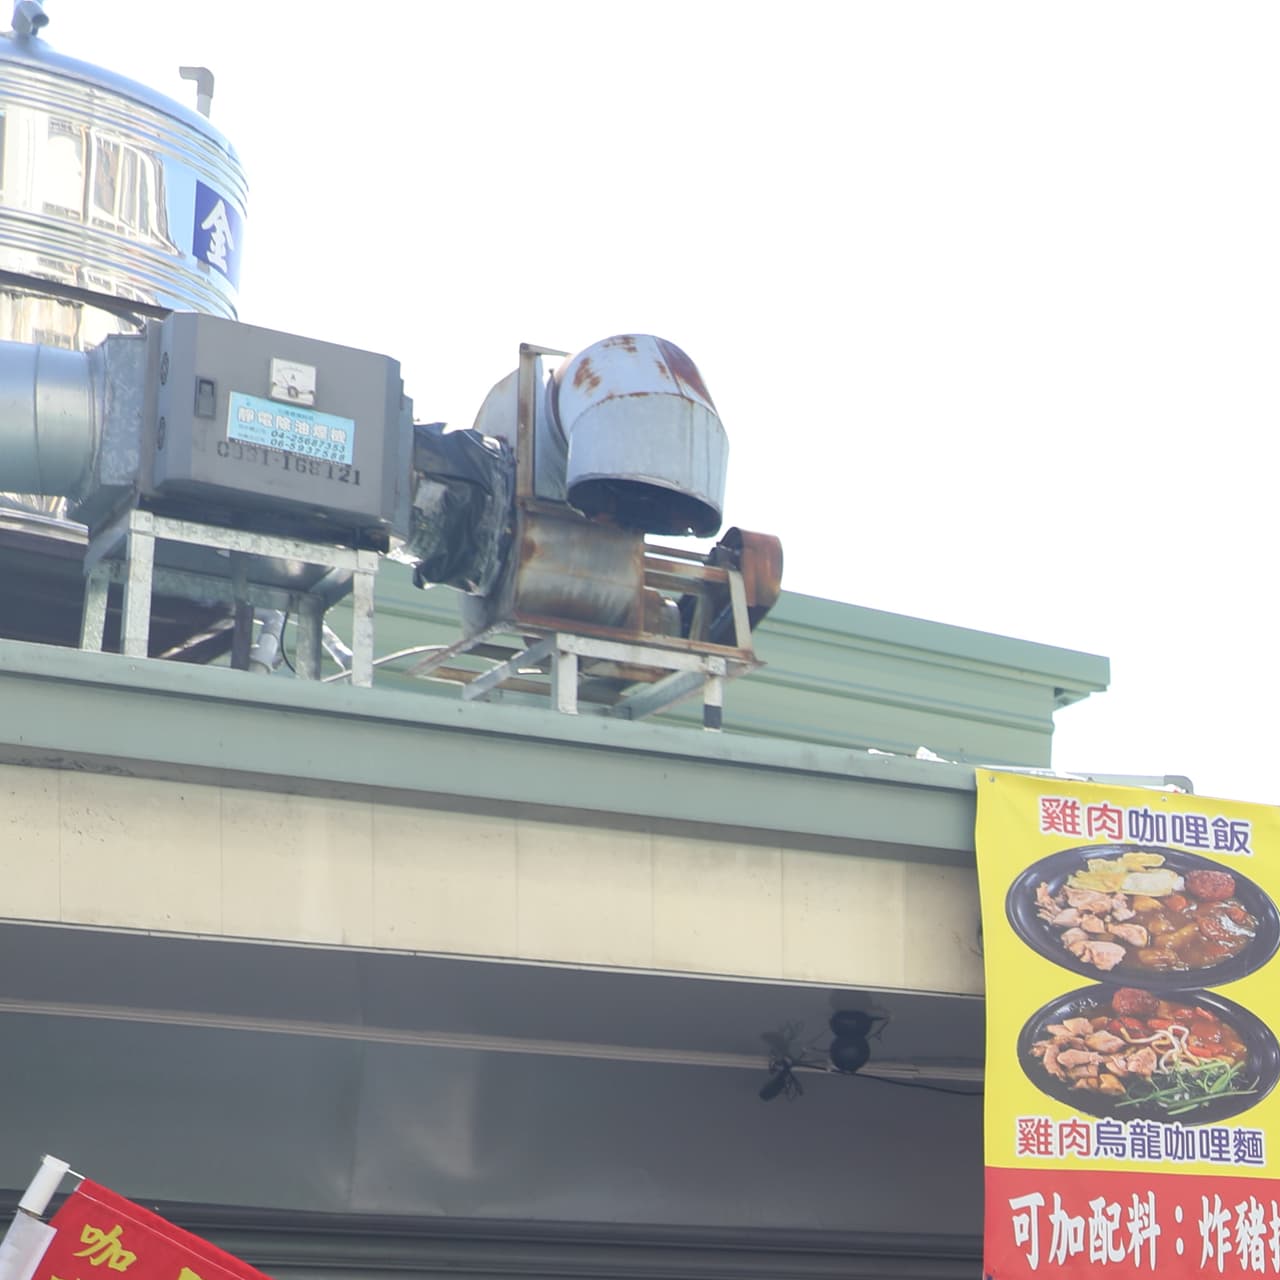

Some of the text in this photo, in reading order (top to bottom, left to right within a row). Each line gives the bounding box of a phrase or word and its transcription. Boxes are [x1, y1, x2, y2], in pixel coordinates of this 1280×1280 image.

[200, 199, 235, 272] 金
[1040, 798, 1252, 855] 雞肉咖哩飯
[1015, 1117, 1265, 1167] 雞肉烏龍咖哩麵
